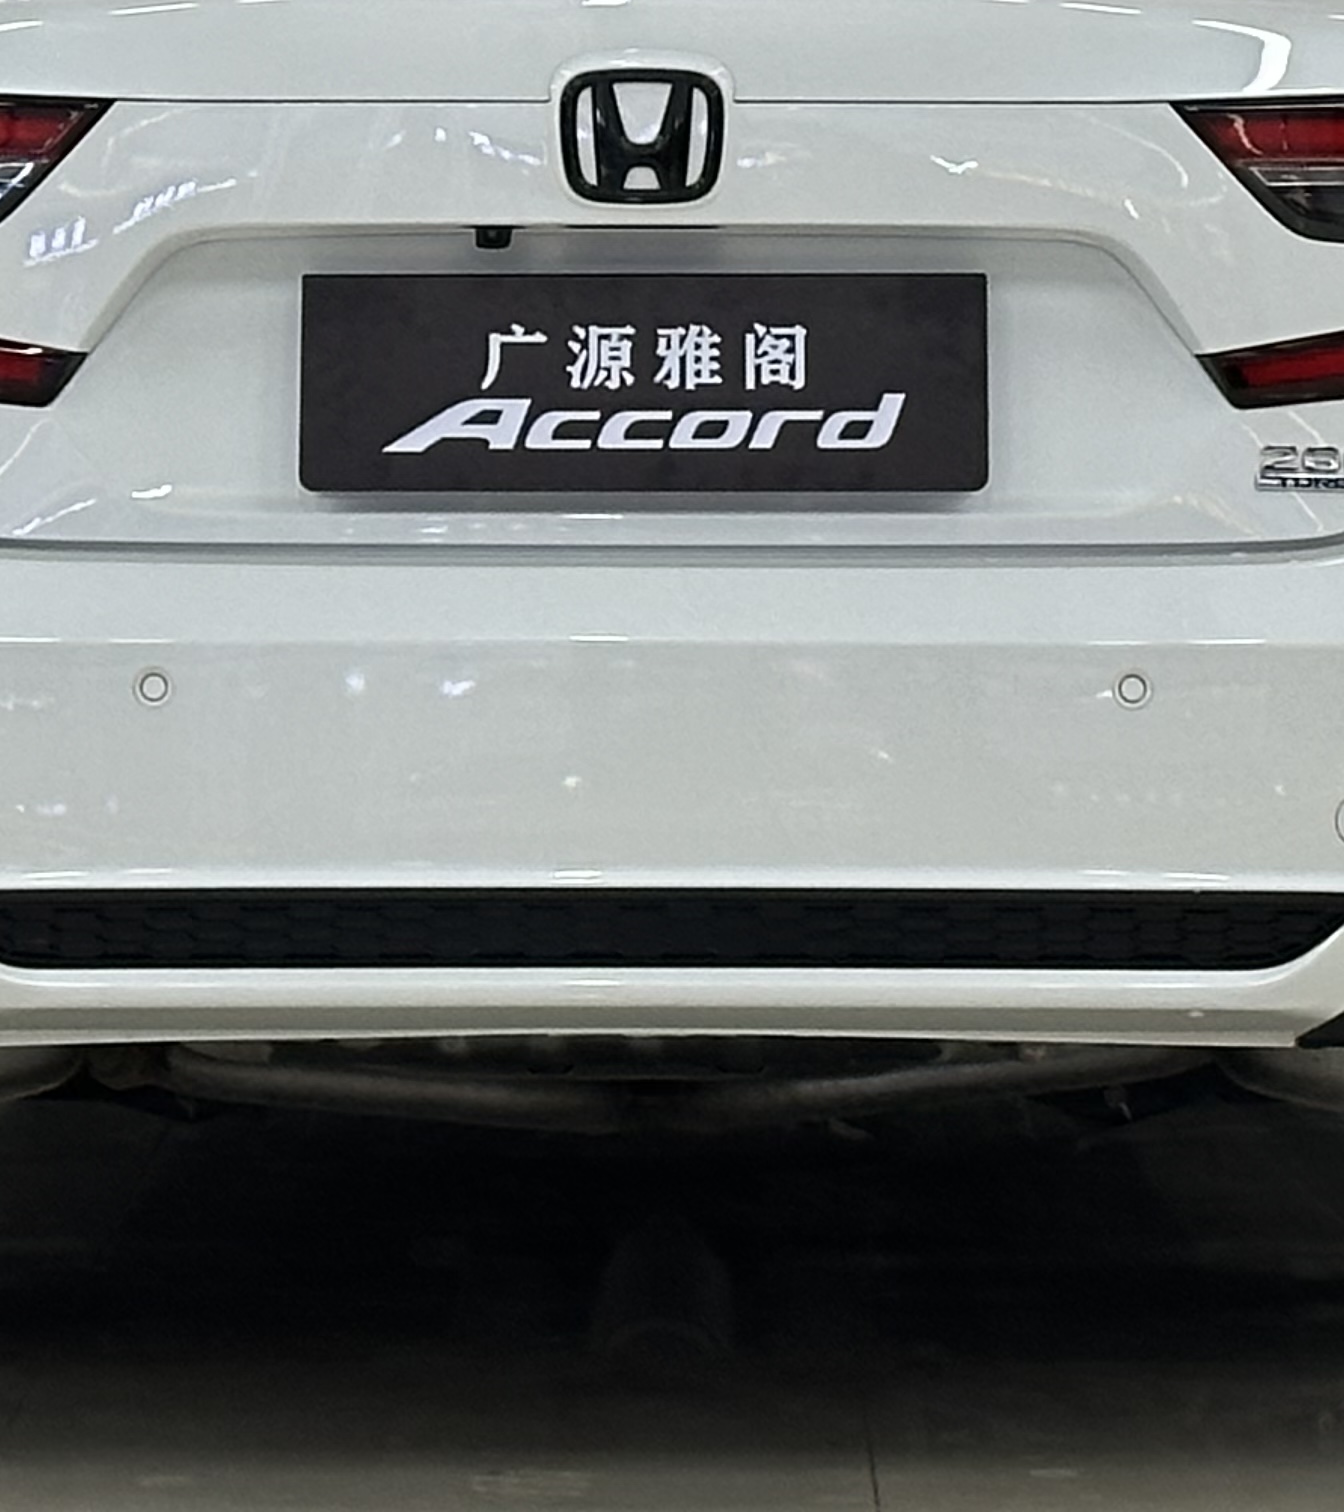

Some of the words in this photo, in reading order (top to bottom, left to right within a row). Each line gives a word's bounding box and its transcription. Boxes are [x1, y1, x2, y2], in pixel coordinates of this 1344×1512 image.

[480, 322, 809, 389] 广源雅阁
[381, 391, 907, 453] Accord
